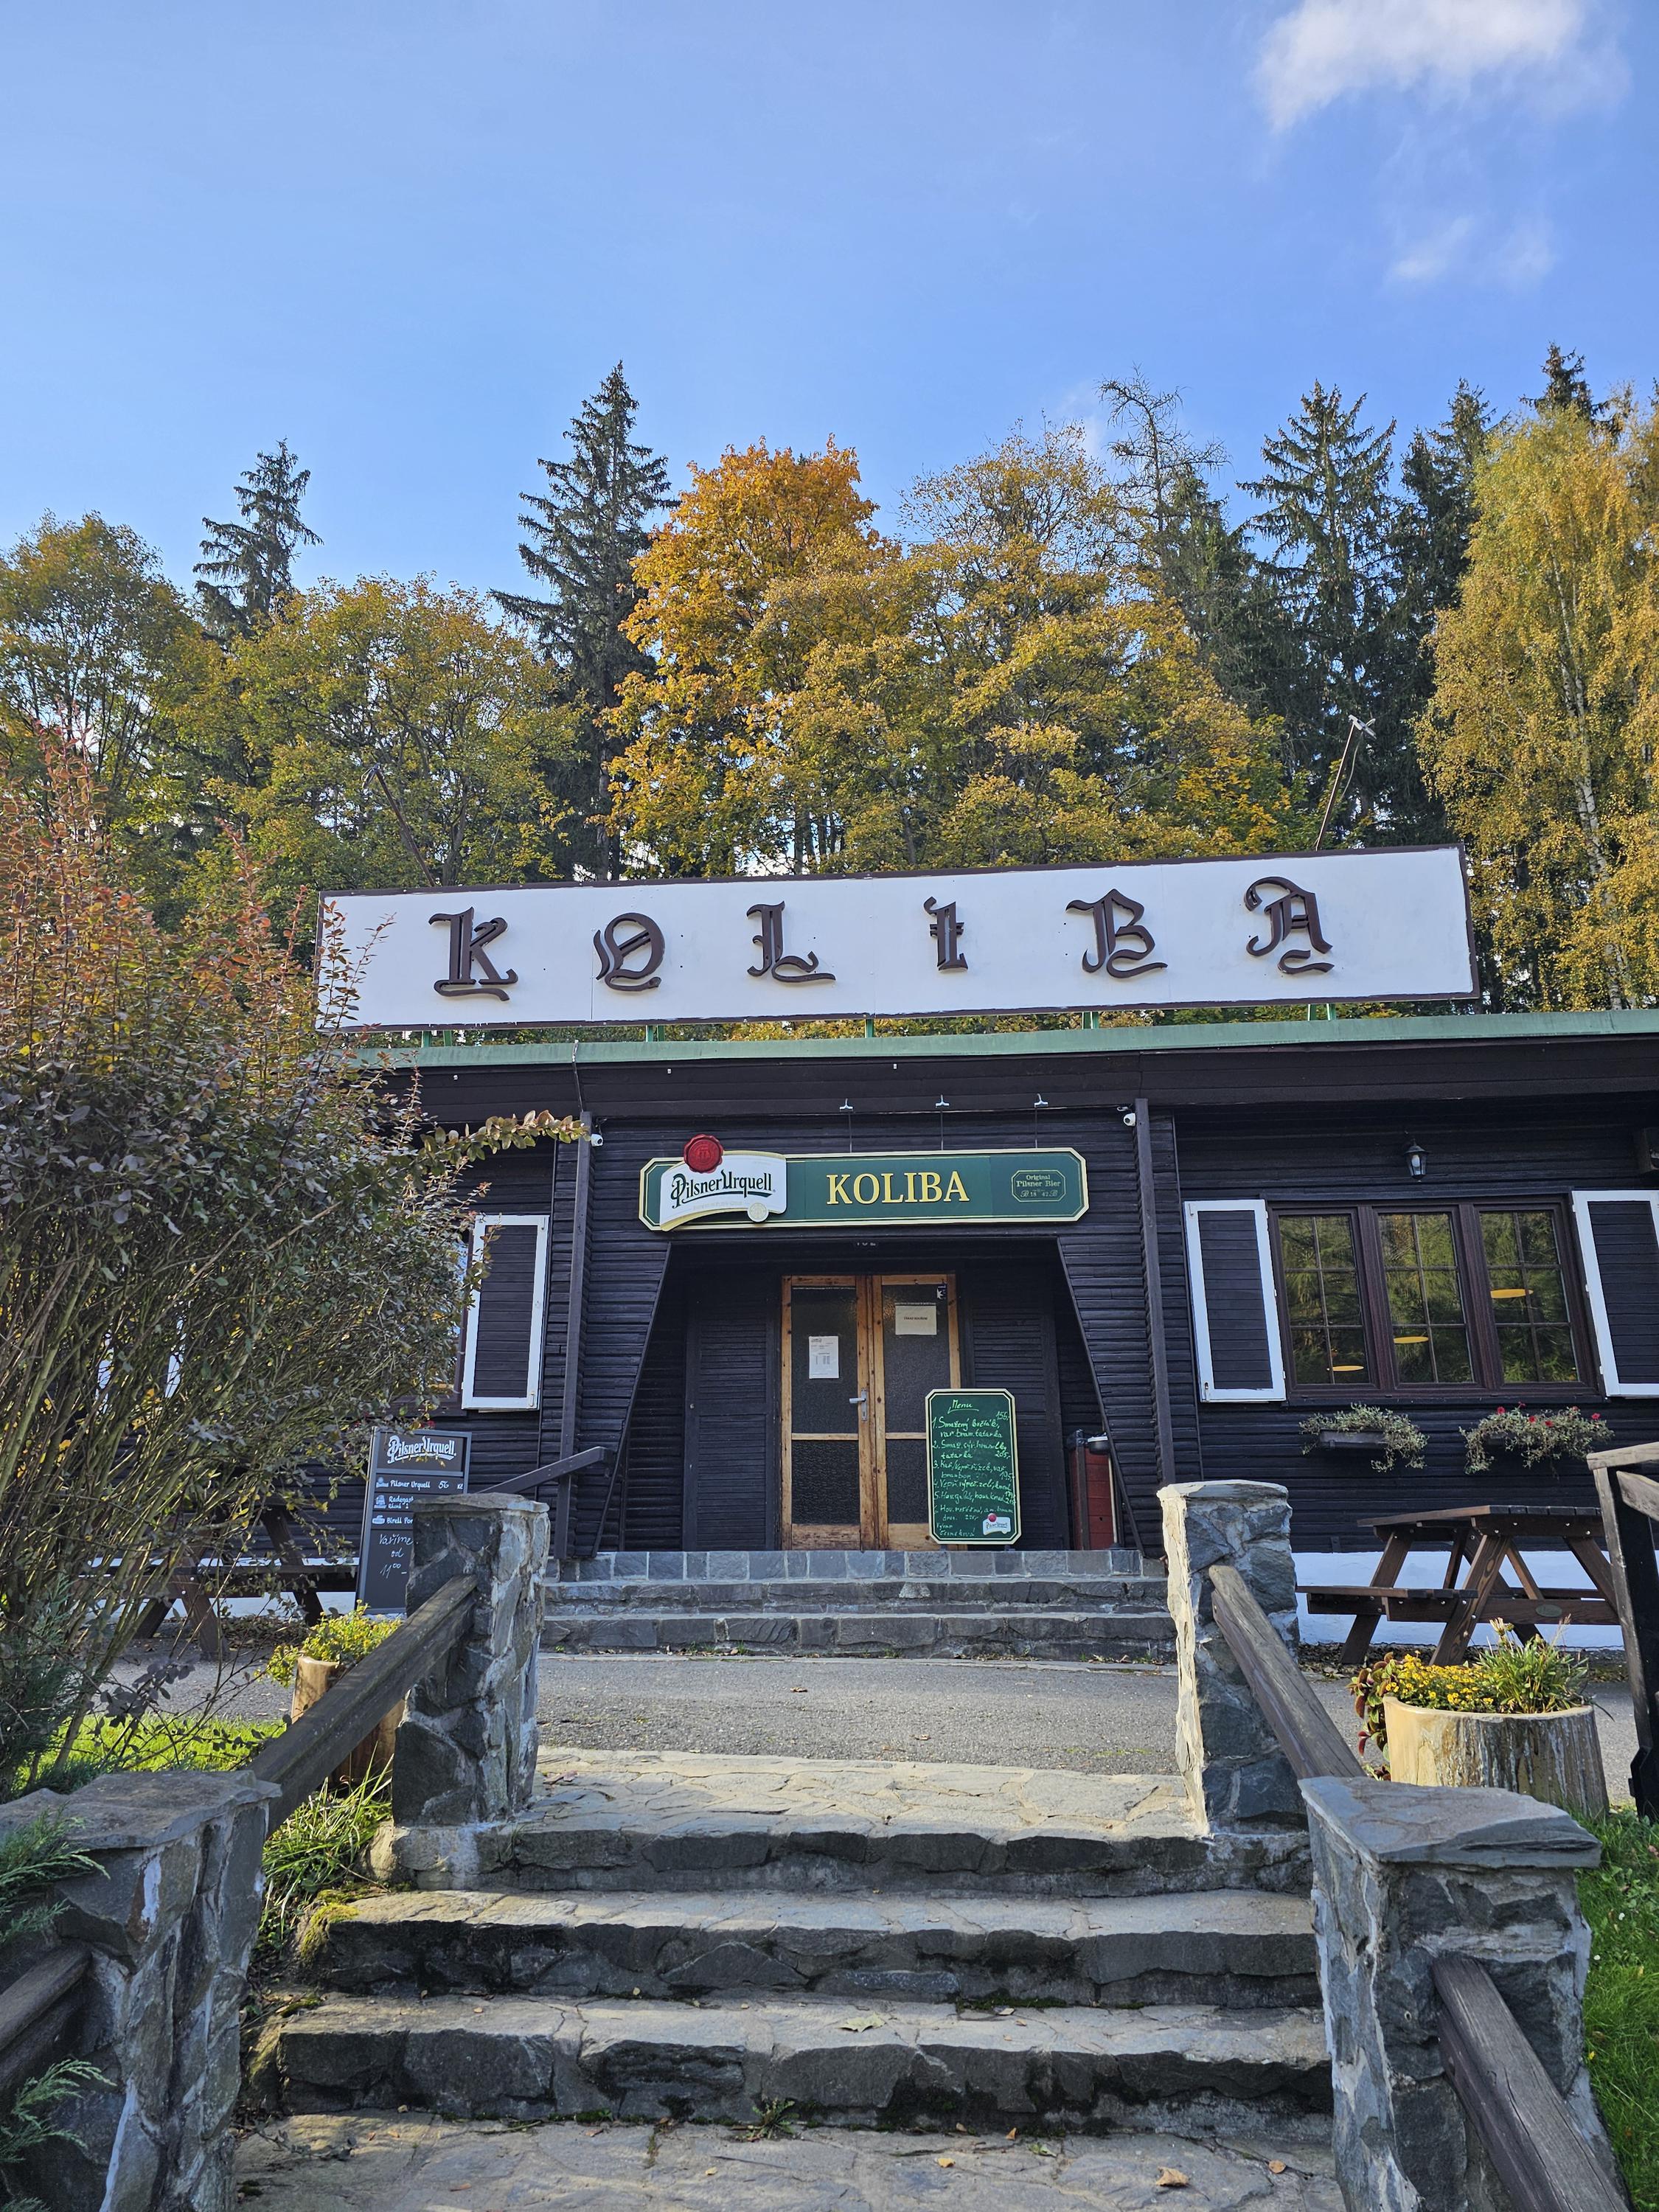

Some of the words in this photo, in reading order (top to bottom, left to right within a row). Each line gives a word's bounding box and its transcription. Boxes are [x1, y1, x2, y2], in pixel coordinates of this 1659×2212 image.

[428, 875, 1335, 1002] KOLIBA
[670, 1173, 723, 1208] Pilsner
[721, 1169, 772, 1198] Urquell
[826, 1171, 970, 1205] KOLIBA
[952, 1399, 973, 1409] Menu
[387, 1435, 423, 1464] Pilsner
[422, 1436, 455, 1455] Urquell
[390, 1480, 410, 1488] Pilsner
[411, 1481, 431, 1491] Urquell
[438, 1481, 449, 1489] 56
[391, 1547, 404, 1558] od
